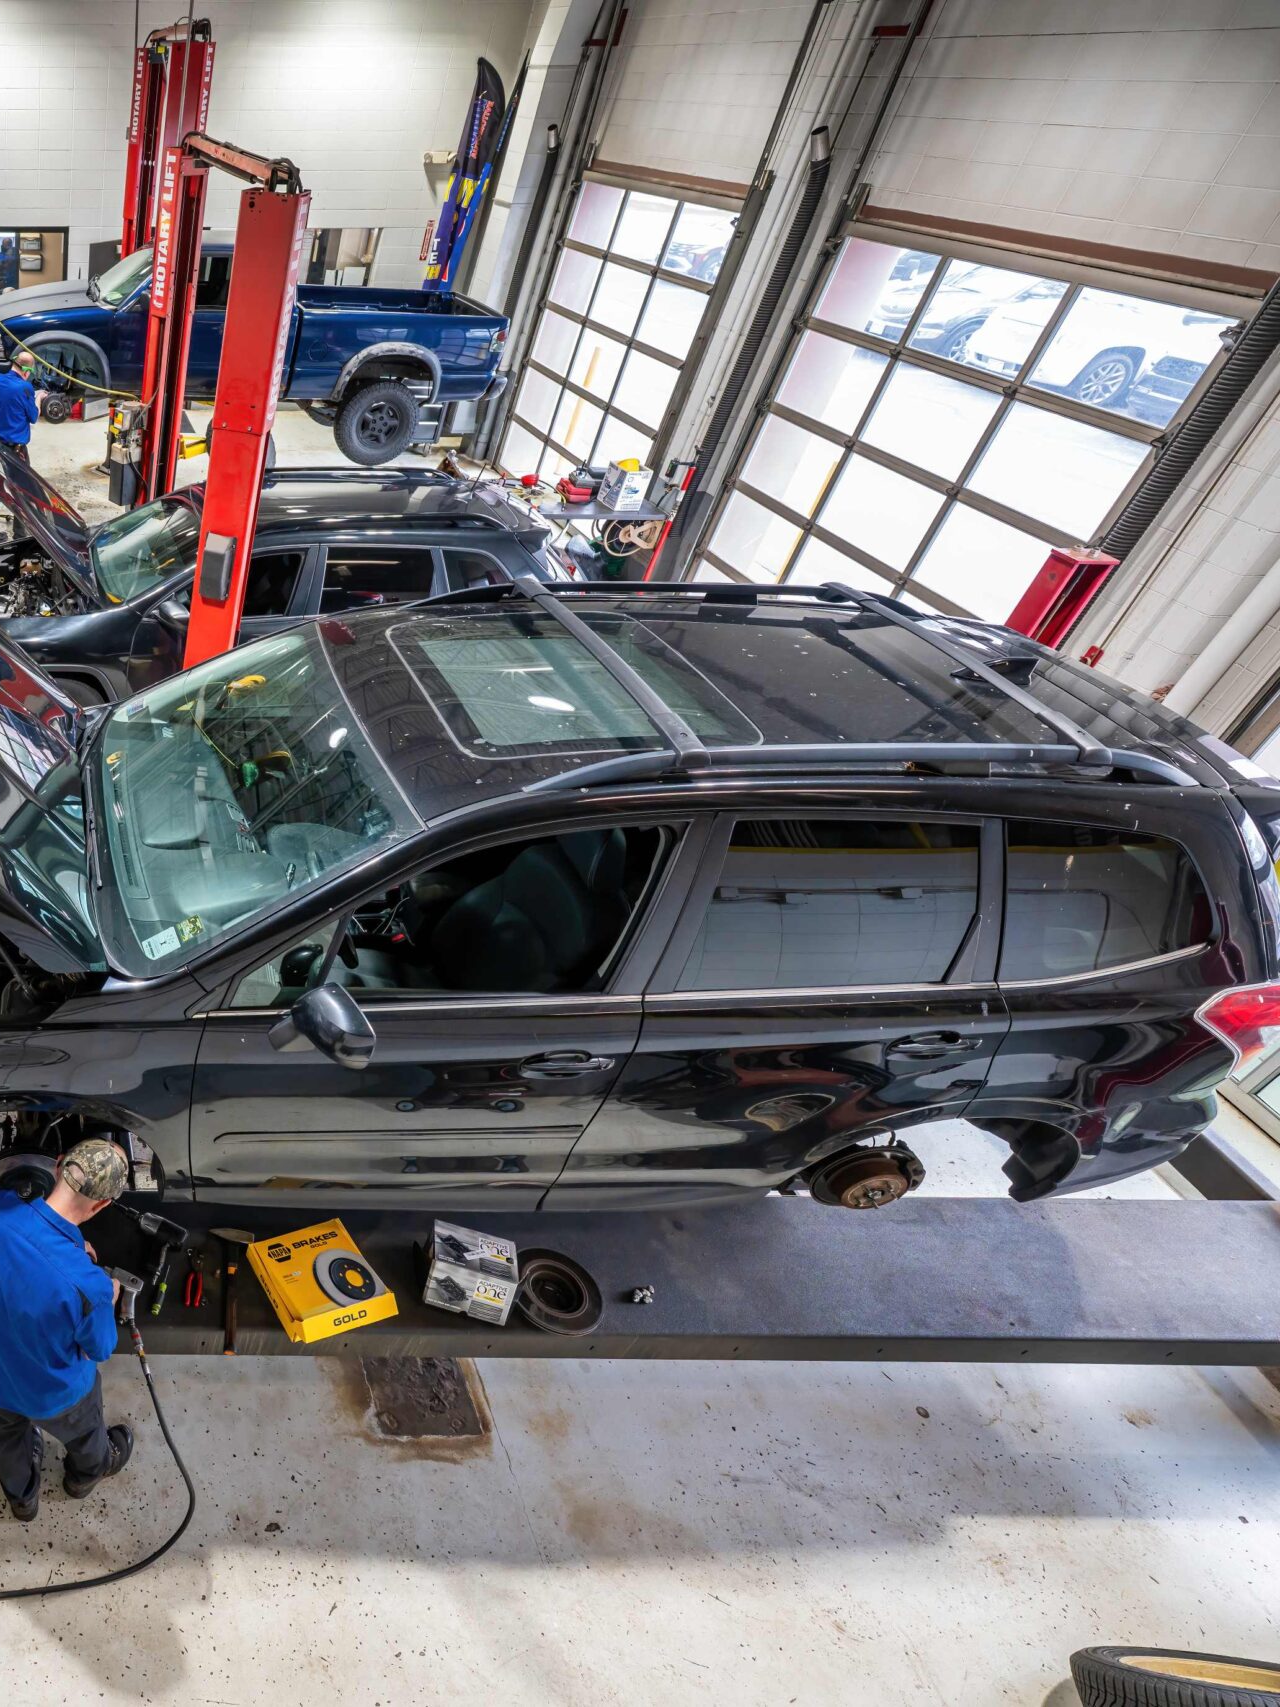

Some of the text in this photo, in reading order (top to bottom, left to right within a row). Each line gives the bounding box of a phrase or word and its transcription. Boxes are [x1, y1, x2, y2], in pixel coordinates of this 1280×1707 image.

[136, 50, 145, 79] LIFT
[203, 45, 214, 82] LIFT
[131, 83, 142, 136] ROTARY
[162, 151, 177, 202] LIFT
[154, 207, 171, 298] ROTARY
[269, 202, 308, 406] ROTARY LIFT
[292, 1231, 338, 1250] BRAKES
[310, 1241, 328, 1249] GOLD
[480, 1239, 509, 1250] ADAPTIVE
[270, 1246, 290, 1260] NAPA
[477, 1284, 507, 1300] one
[479, 1281, 508, 1293] ADAPTIVE
[333, 1309, 368, 1327] GOLD
